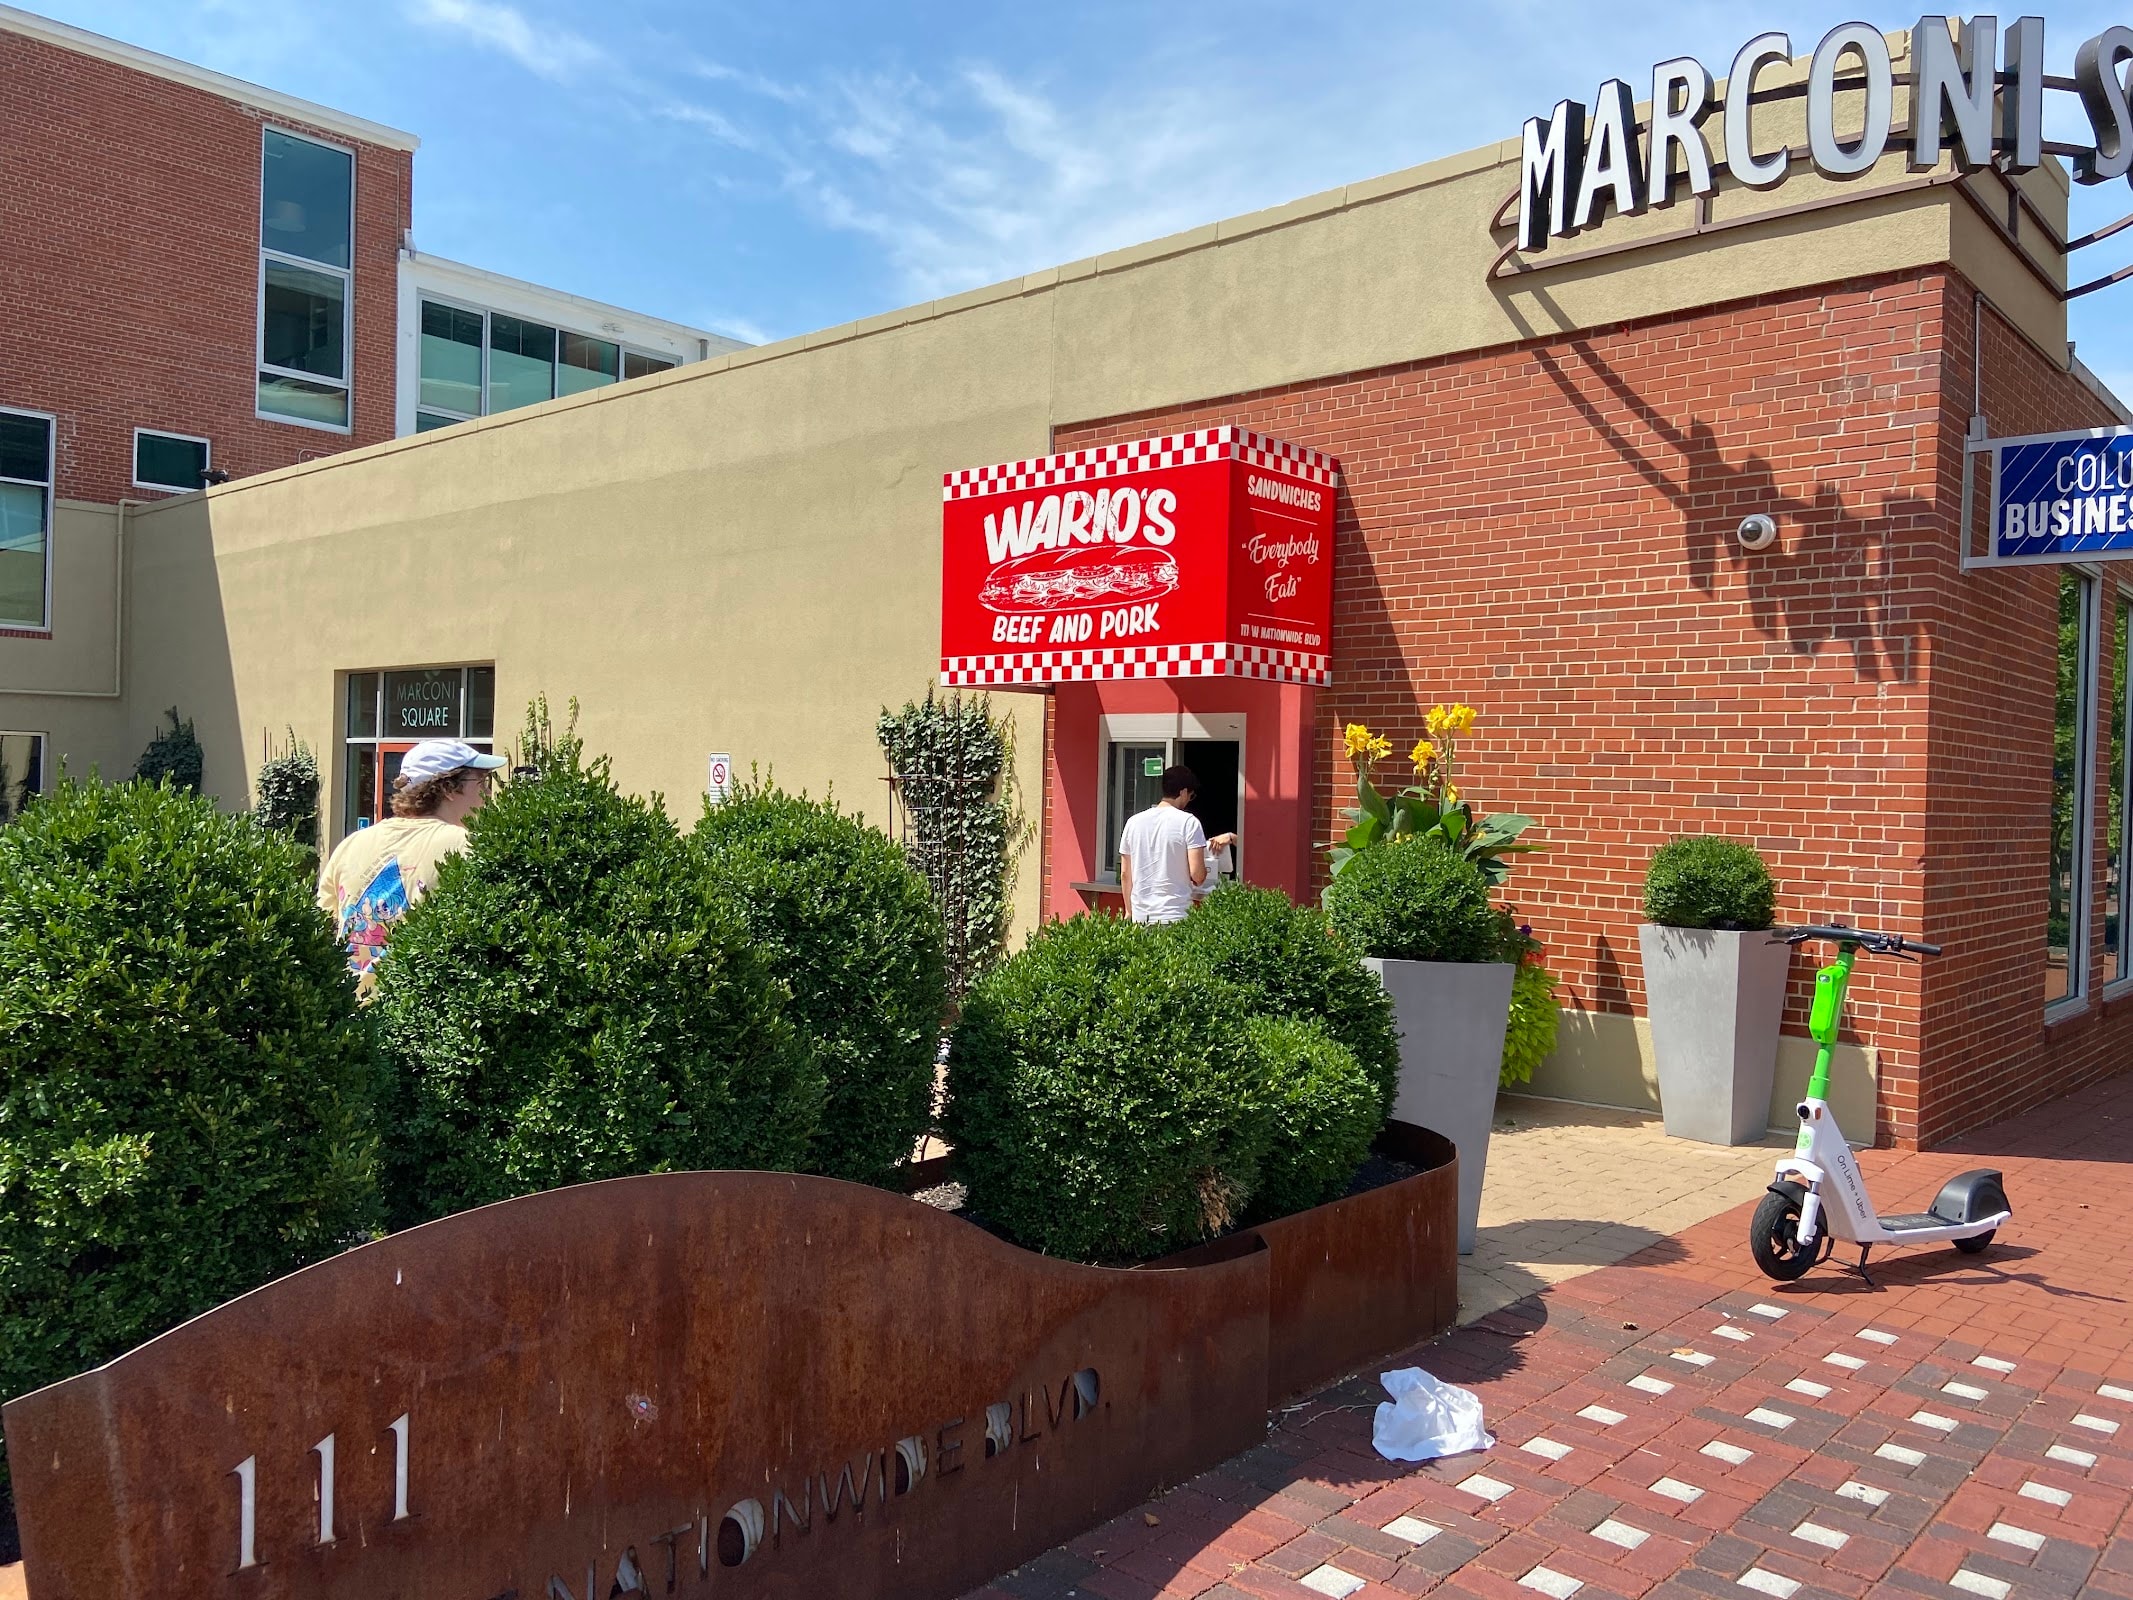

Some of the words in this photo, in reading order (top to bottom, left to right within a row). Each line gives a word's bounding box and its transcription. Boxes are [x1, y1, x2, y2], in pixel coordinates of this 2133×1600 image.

[1518, 15, 2045, 252] MARCONI
[2079, 25, 2133, 187] S
[1247, 474, 1322, 512] SANDWICHES
[983, 487, 1178, 565] WARIO'S
[2005, 494, 2133, 540] BUSINE
[992, 615, 1045, 644] BEEF
[1048, 612, 1094, 643] AND
[1099, 602, 1161, 641] PORK
[1251, 625, 1260, 639] W
[1260, 626, 1304, 644] NATIONWIDE
[1304, 632, 1321, 647] BLVD
[397, 680, 456, 702] MARCONI
[401, 706, 449, 728] SQUARE
[1837, 1155, 1847, 1170] On
[1843, 1168, 1856, 1192] Lime
[1855, 1197, 1867, 1219] Uber
[984, 1367, 1111, 1459] BLVD.
[225, 1411, 421, 1578] 111
